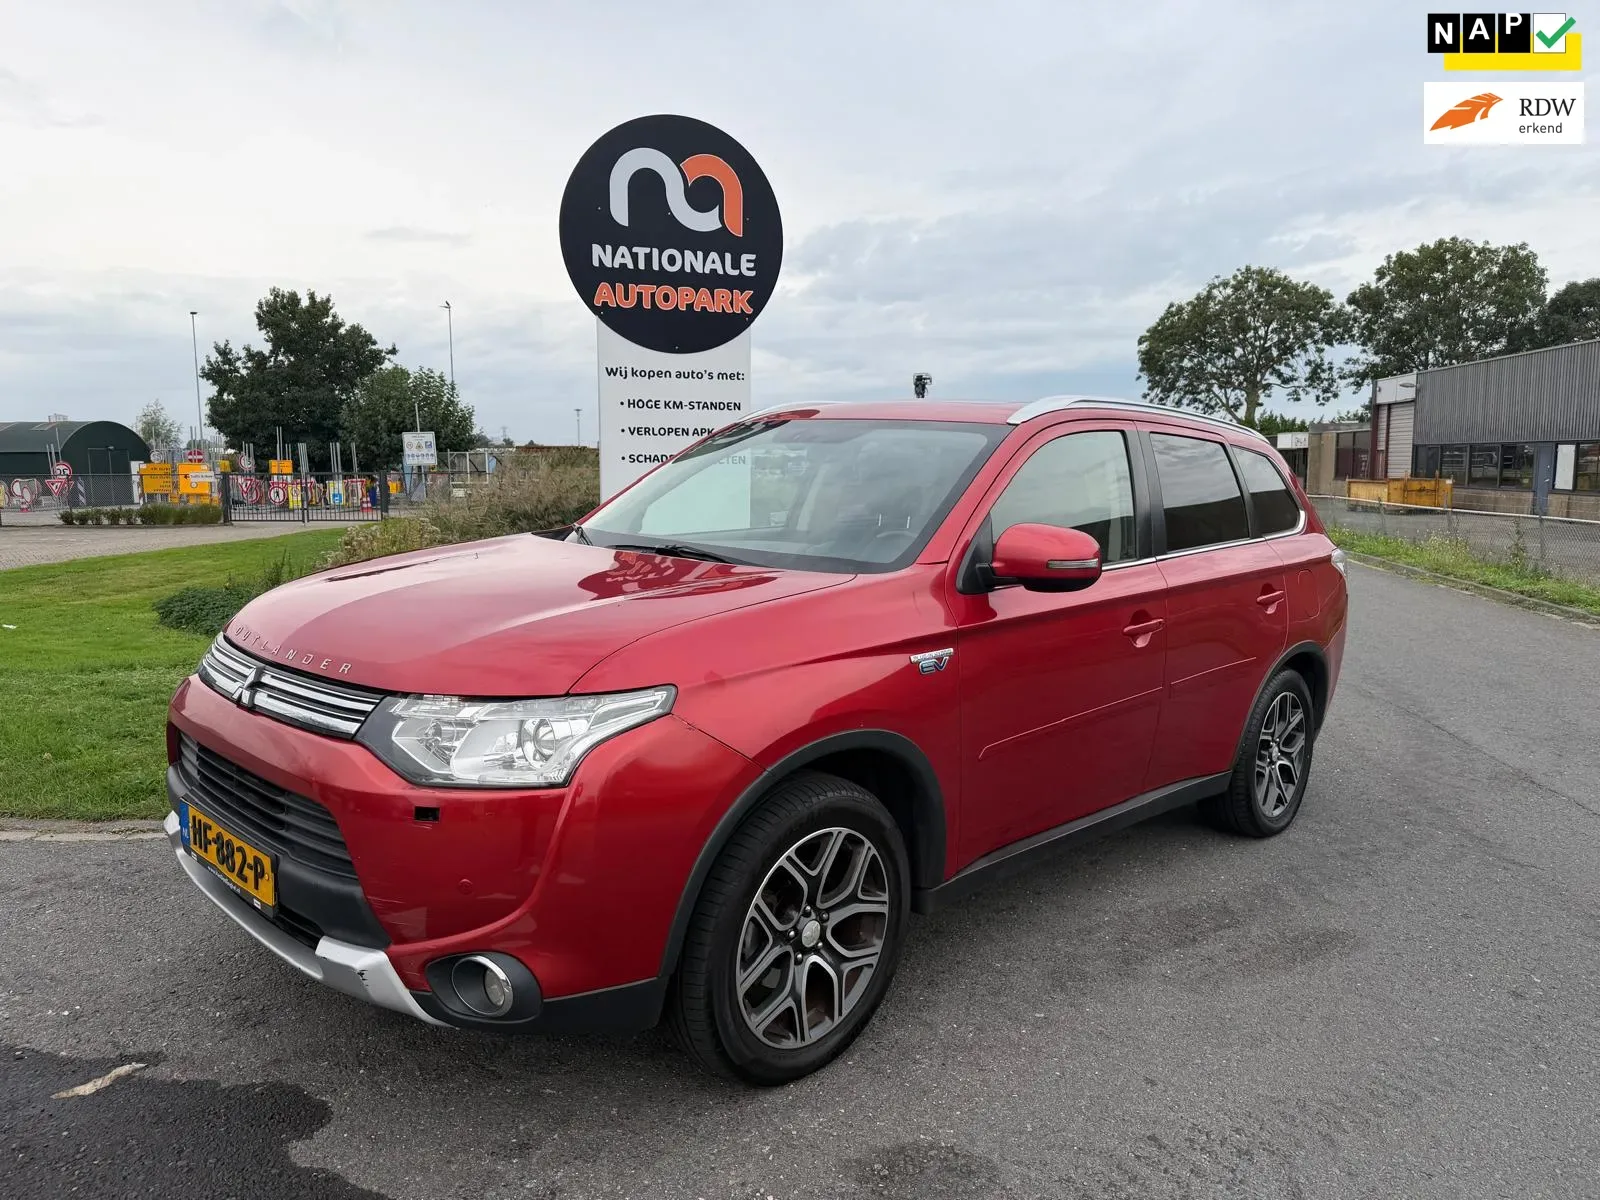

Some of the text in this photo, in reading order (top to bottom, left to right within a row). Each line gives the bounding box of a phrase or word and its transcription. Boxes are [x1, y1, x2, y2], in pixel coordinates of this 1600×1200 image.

[591, 243, 757, 277] NATIONALE
[593, 281, 754, 315] AUTOPARK
[605, 367, 745, 381] Wij kopen auto's met:
[627, 398, 741, 411] HOGE KM-STANDEN
[628, 426, 690, 437] VERLOPEN
[235, 626, 353, 675] OUTLANDER
[191, 815, 265, 891] HF-882-P
